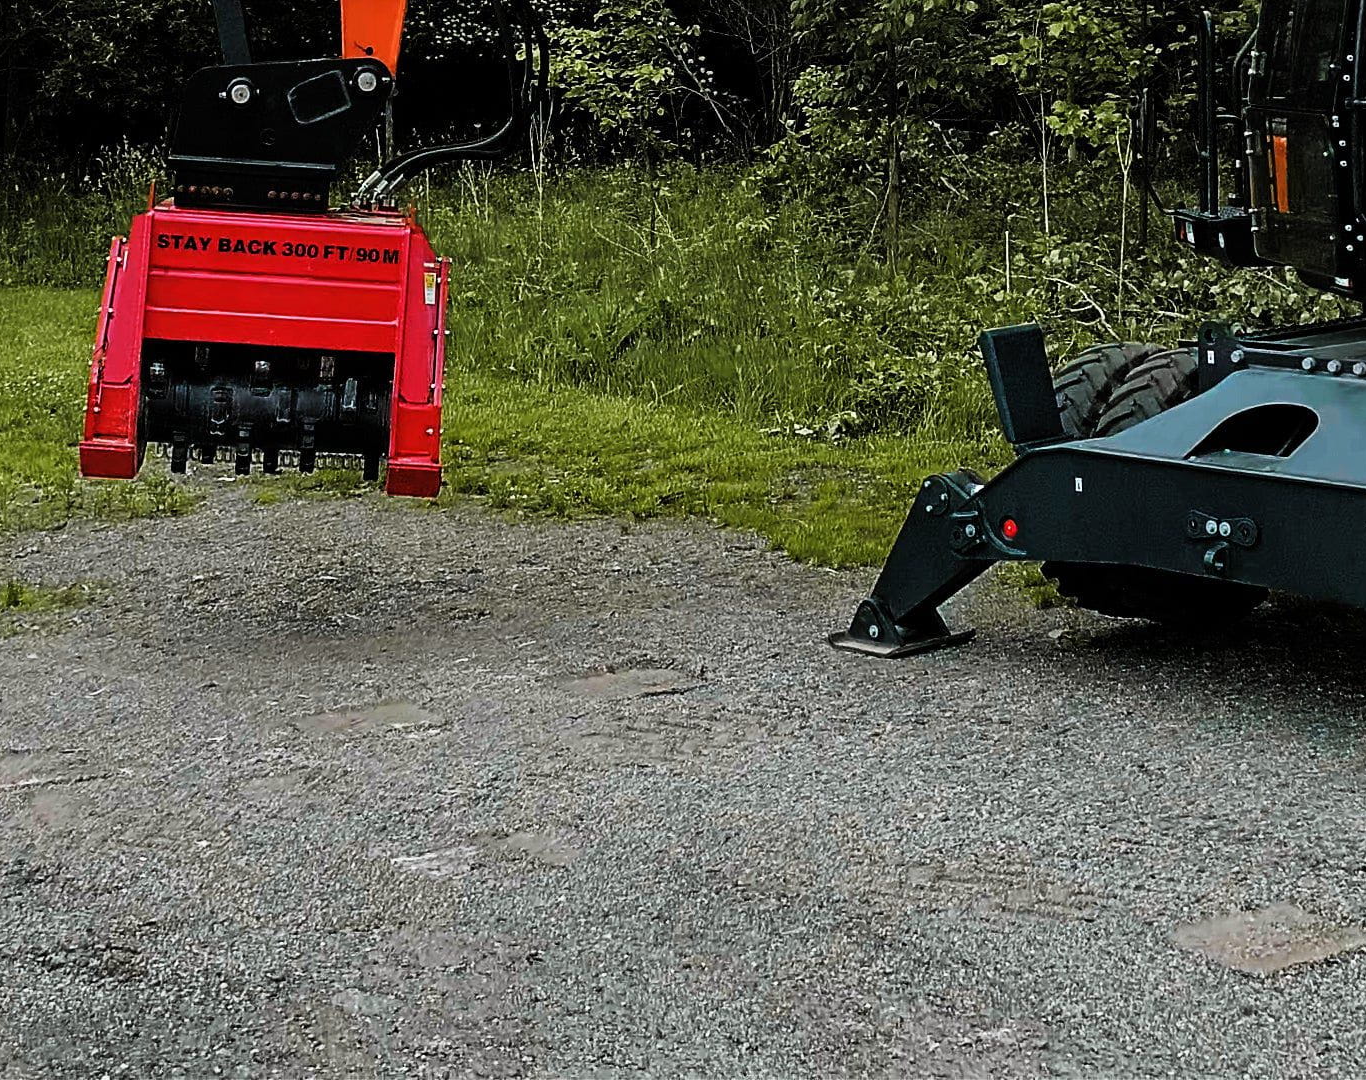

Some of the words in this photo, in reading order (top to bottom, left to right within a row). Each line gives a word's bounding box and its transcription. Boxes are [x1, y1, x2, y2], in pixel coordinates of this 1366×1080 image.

[157, 234, 212, 251] STAY
[218, 238, 277, 256] BACK
[281, 242, 319, 258] 300
